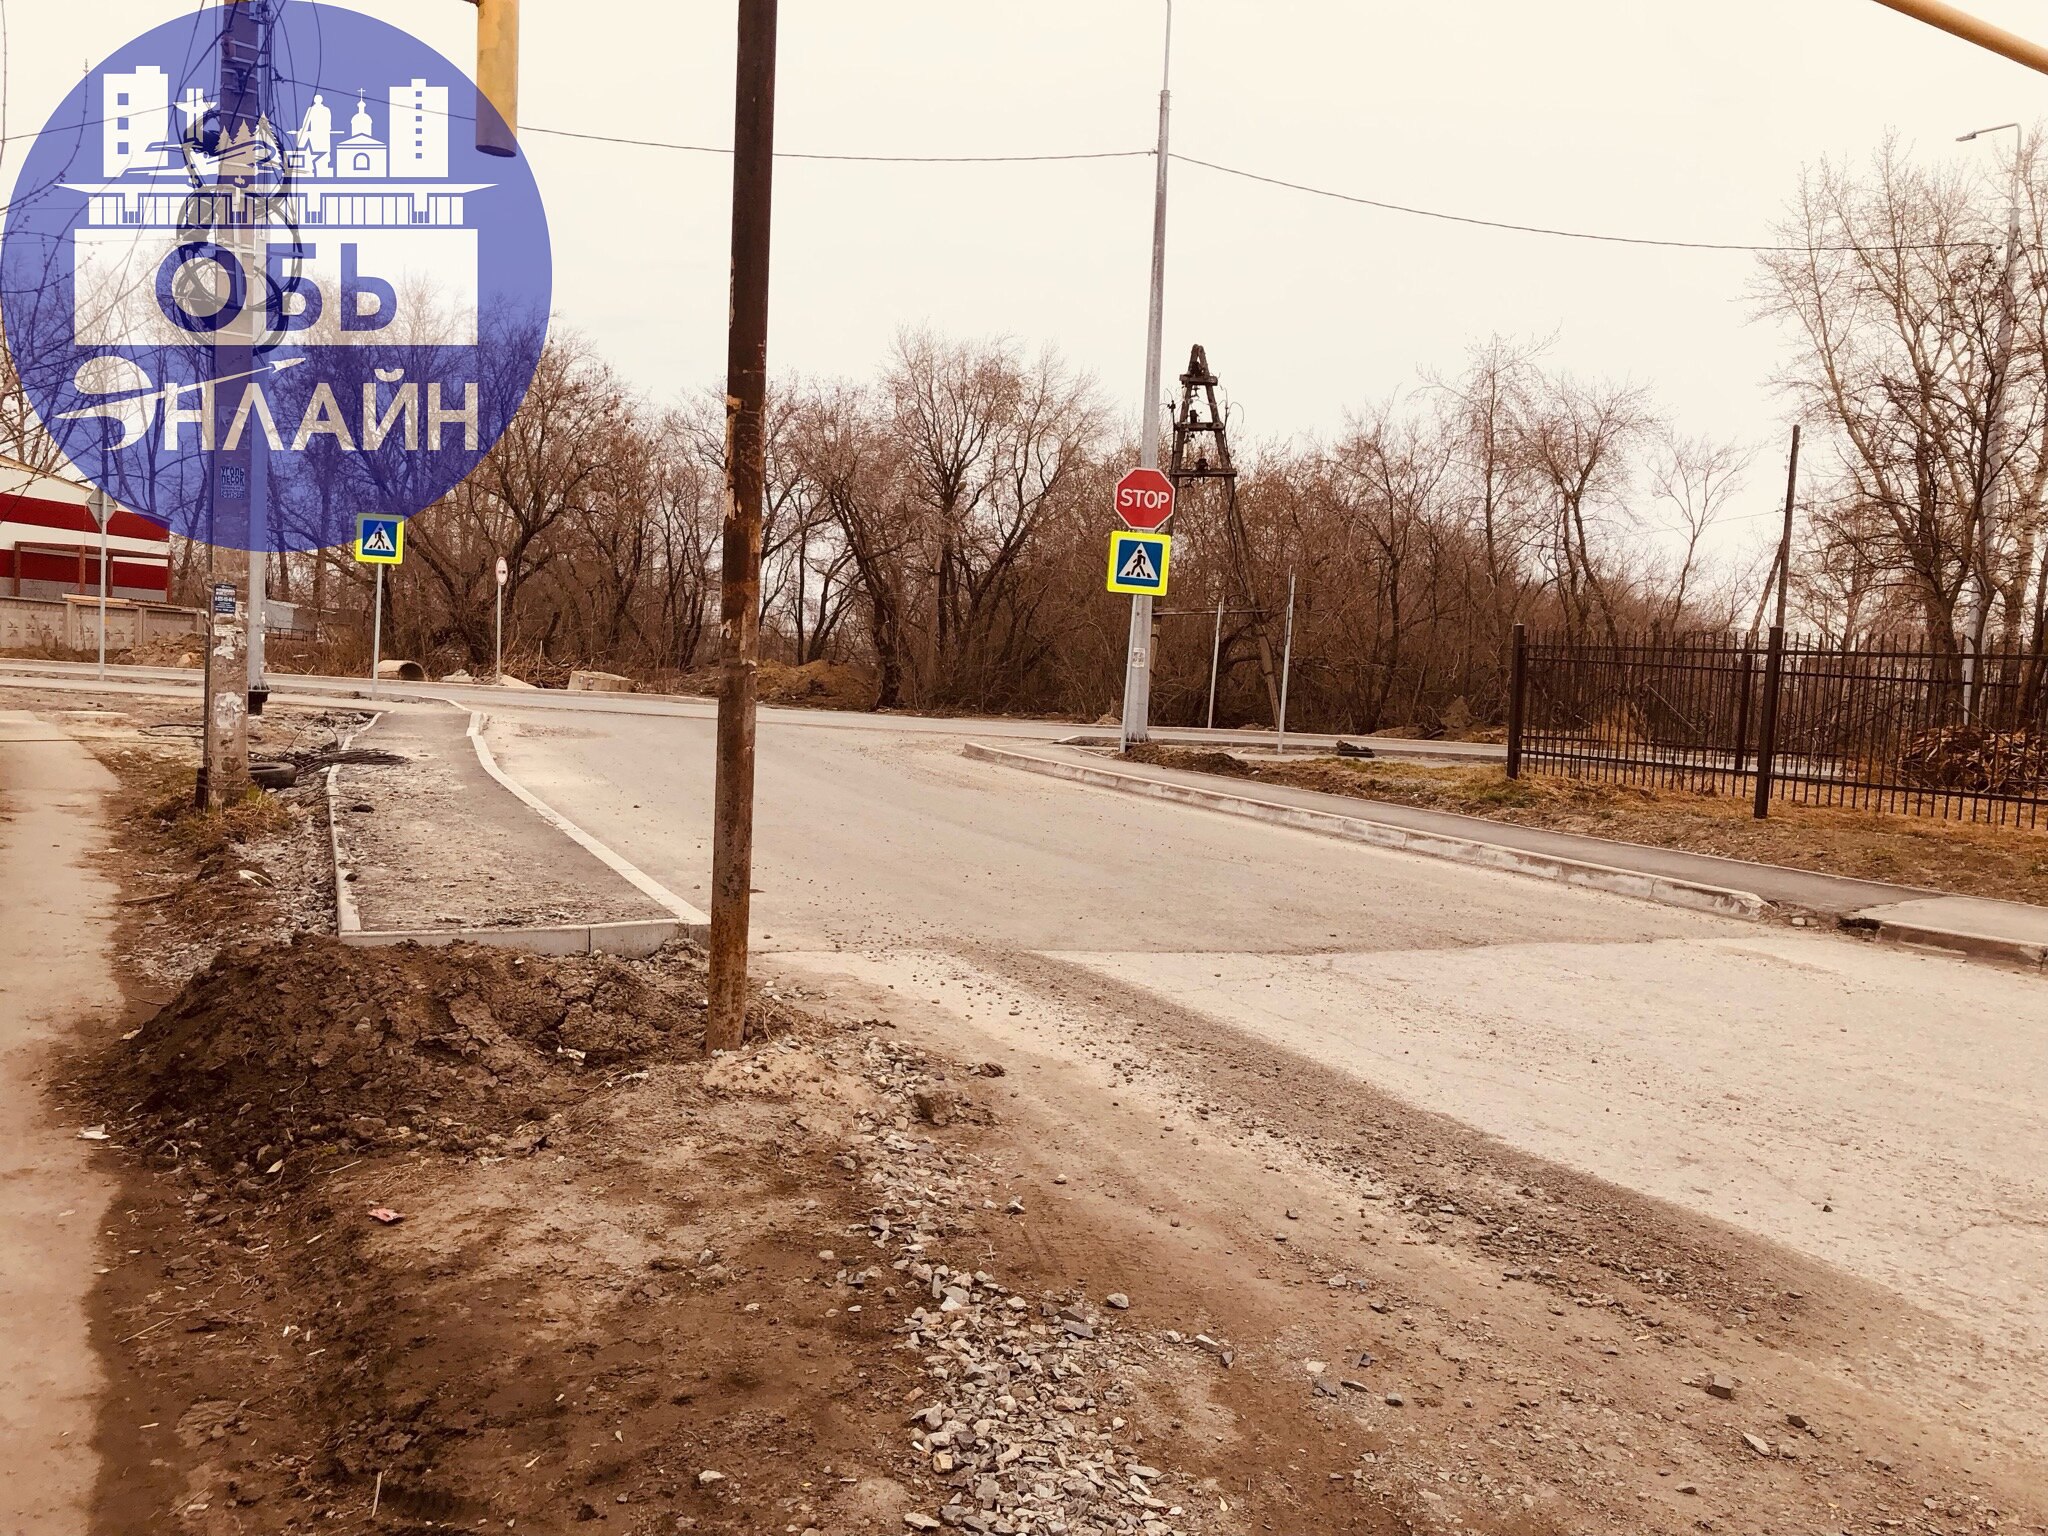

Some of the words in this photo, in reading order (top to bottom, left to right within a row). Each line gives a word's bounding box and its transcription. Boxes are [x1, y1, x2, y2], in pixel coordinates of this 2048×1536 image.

[220, 466, 245, 476] УГОЛЬ
[221, 475, 245, 486] ПЕСОК
[1120, 488, 1169, 509] STOP
